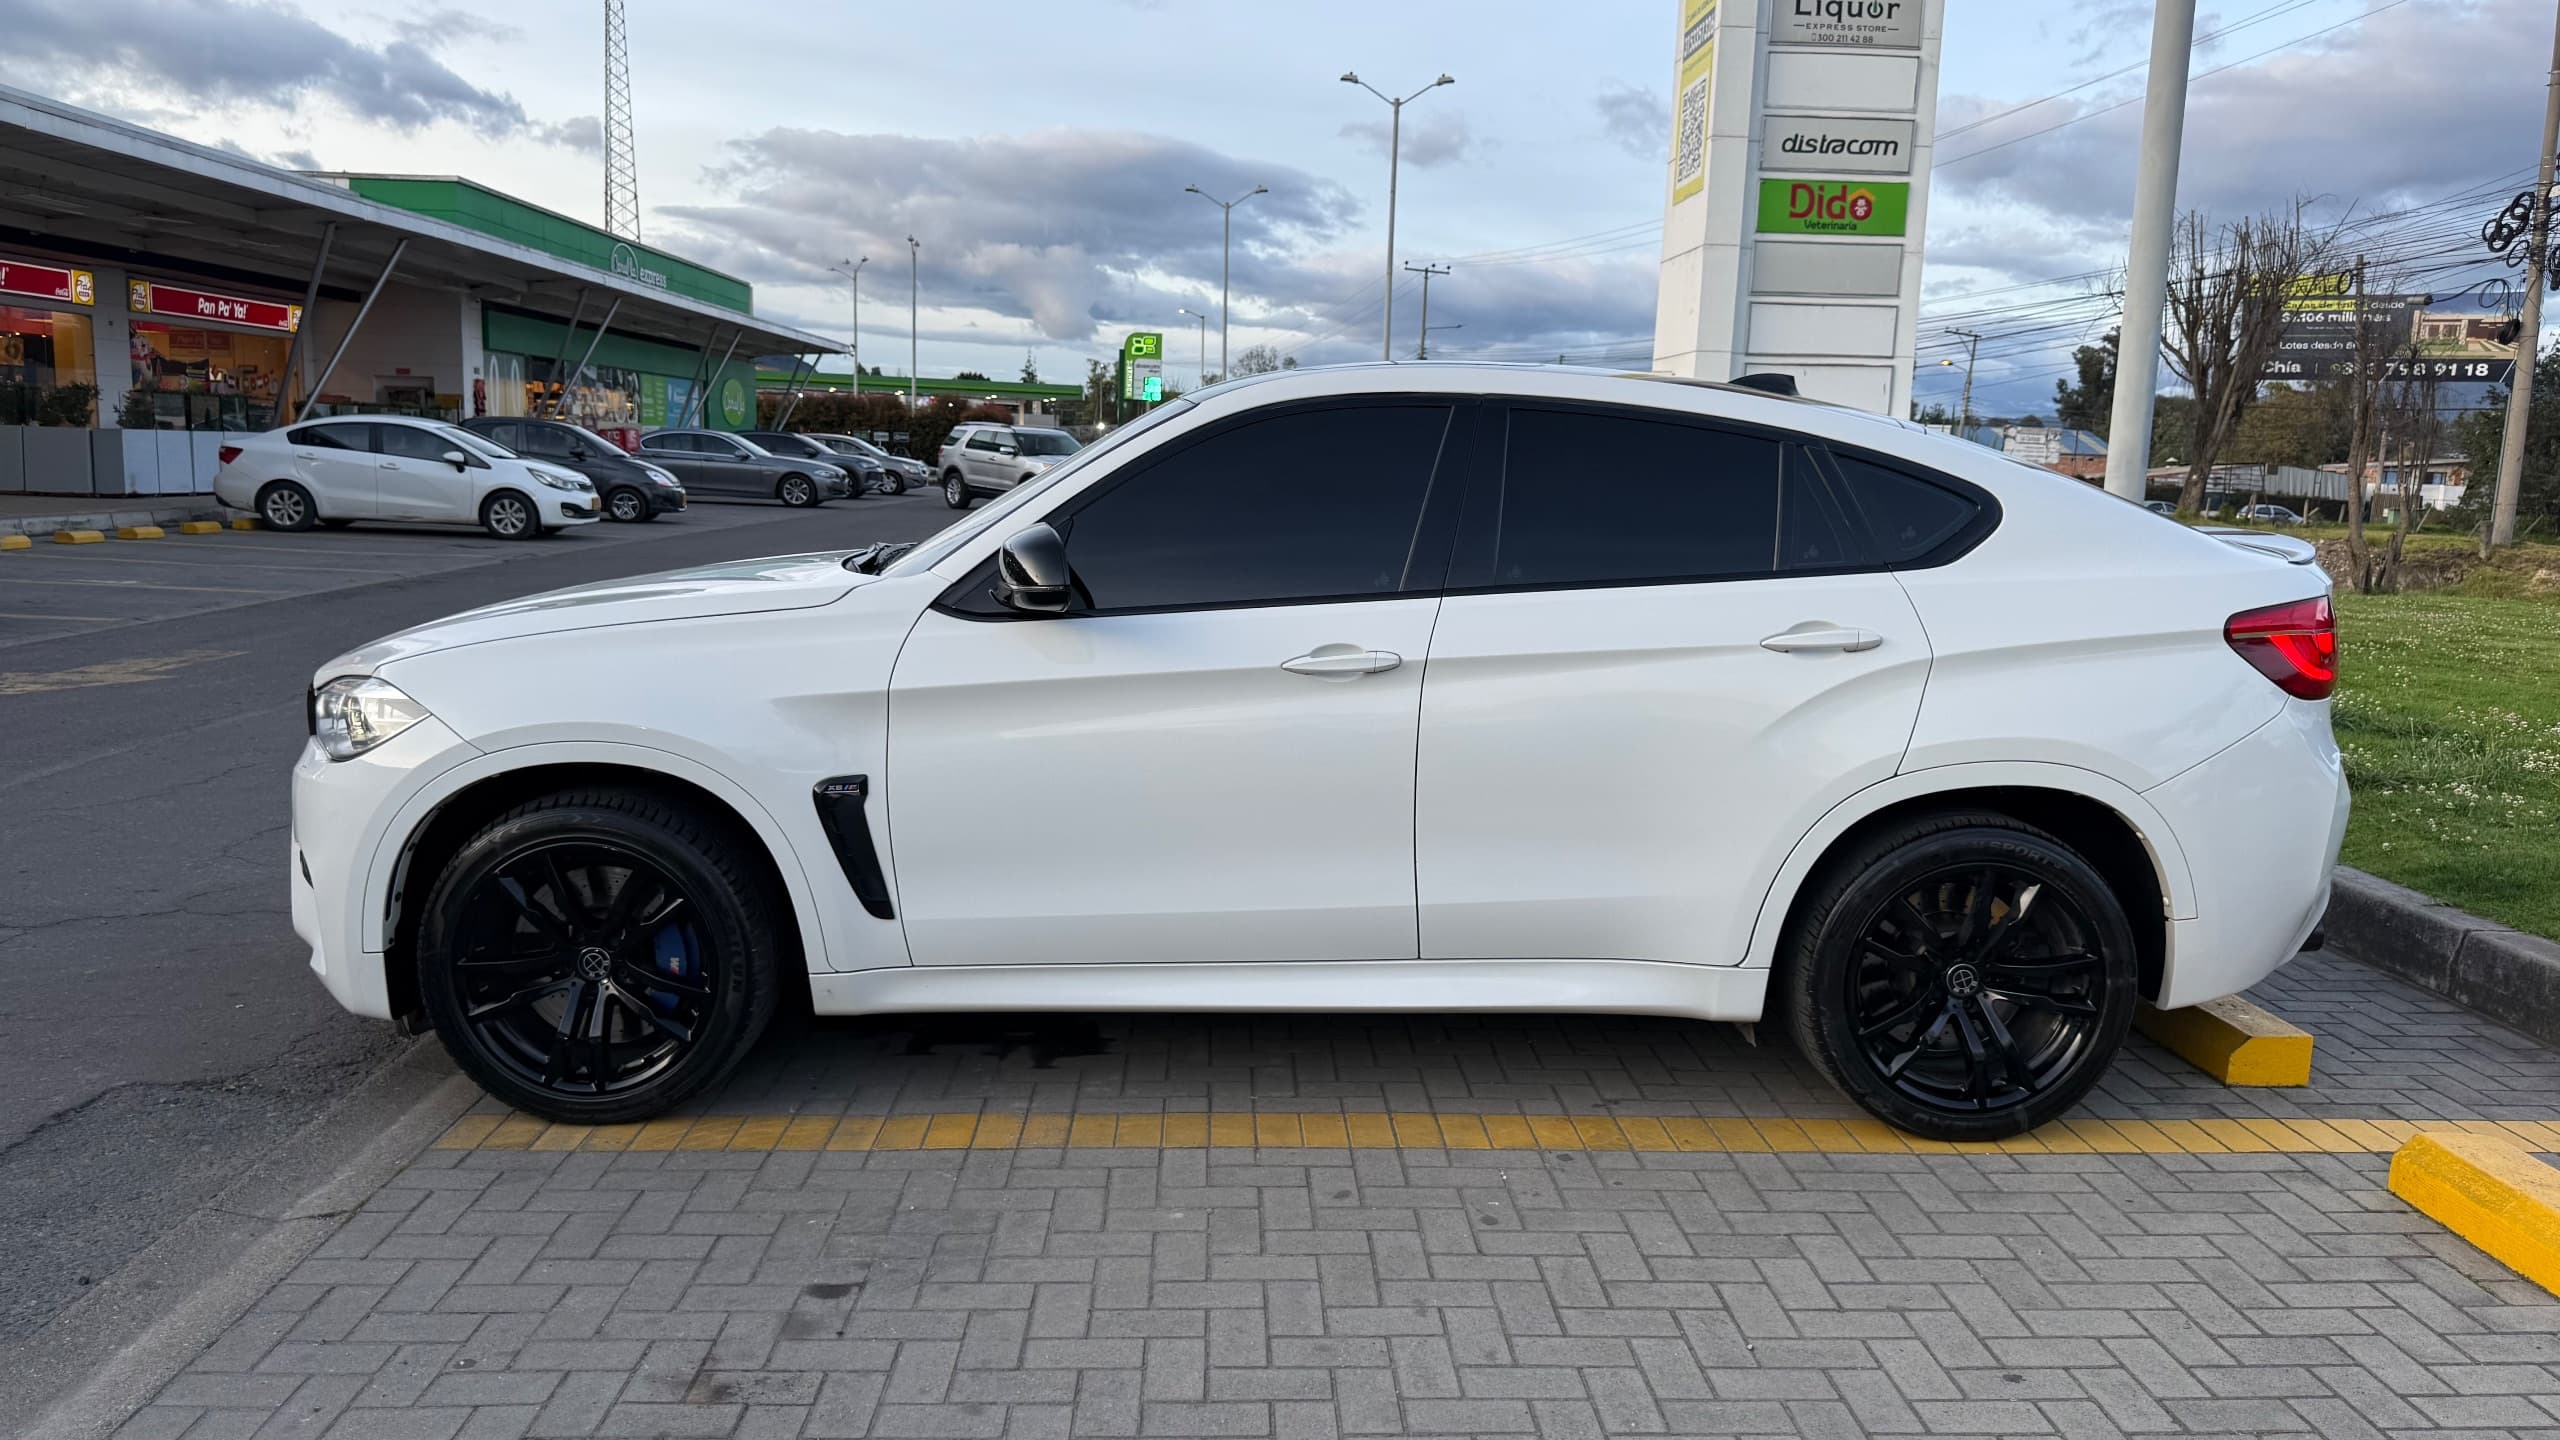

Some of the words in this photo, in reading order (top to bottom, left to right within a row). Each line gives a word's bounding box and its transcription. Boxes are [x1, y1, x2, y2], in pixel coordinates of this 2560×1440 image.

[1794, 0, 1901, 23] Liquor
[1805, 22, 1854, 32] EXPRESS
[1856, 25, 1887, 33] STORE
[1781, 133, 1899, 156] distracom
[1789, 183, 1873, 221] Dido
[1804, 219, 1857, 231] Veterinaria
[640, 267, 667, 288] express
[198, 297, 216, 316] Pan
[2279, 341, 2309, 350] Lotes
